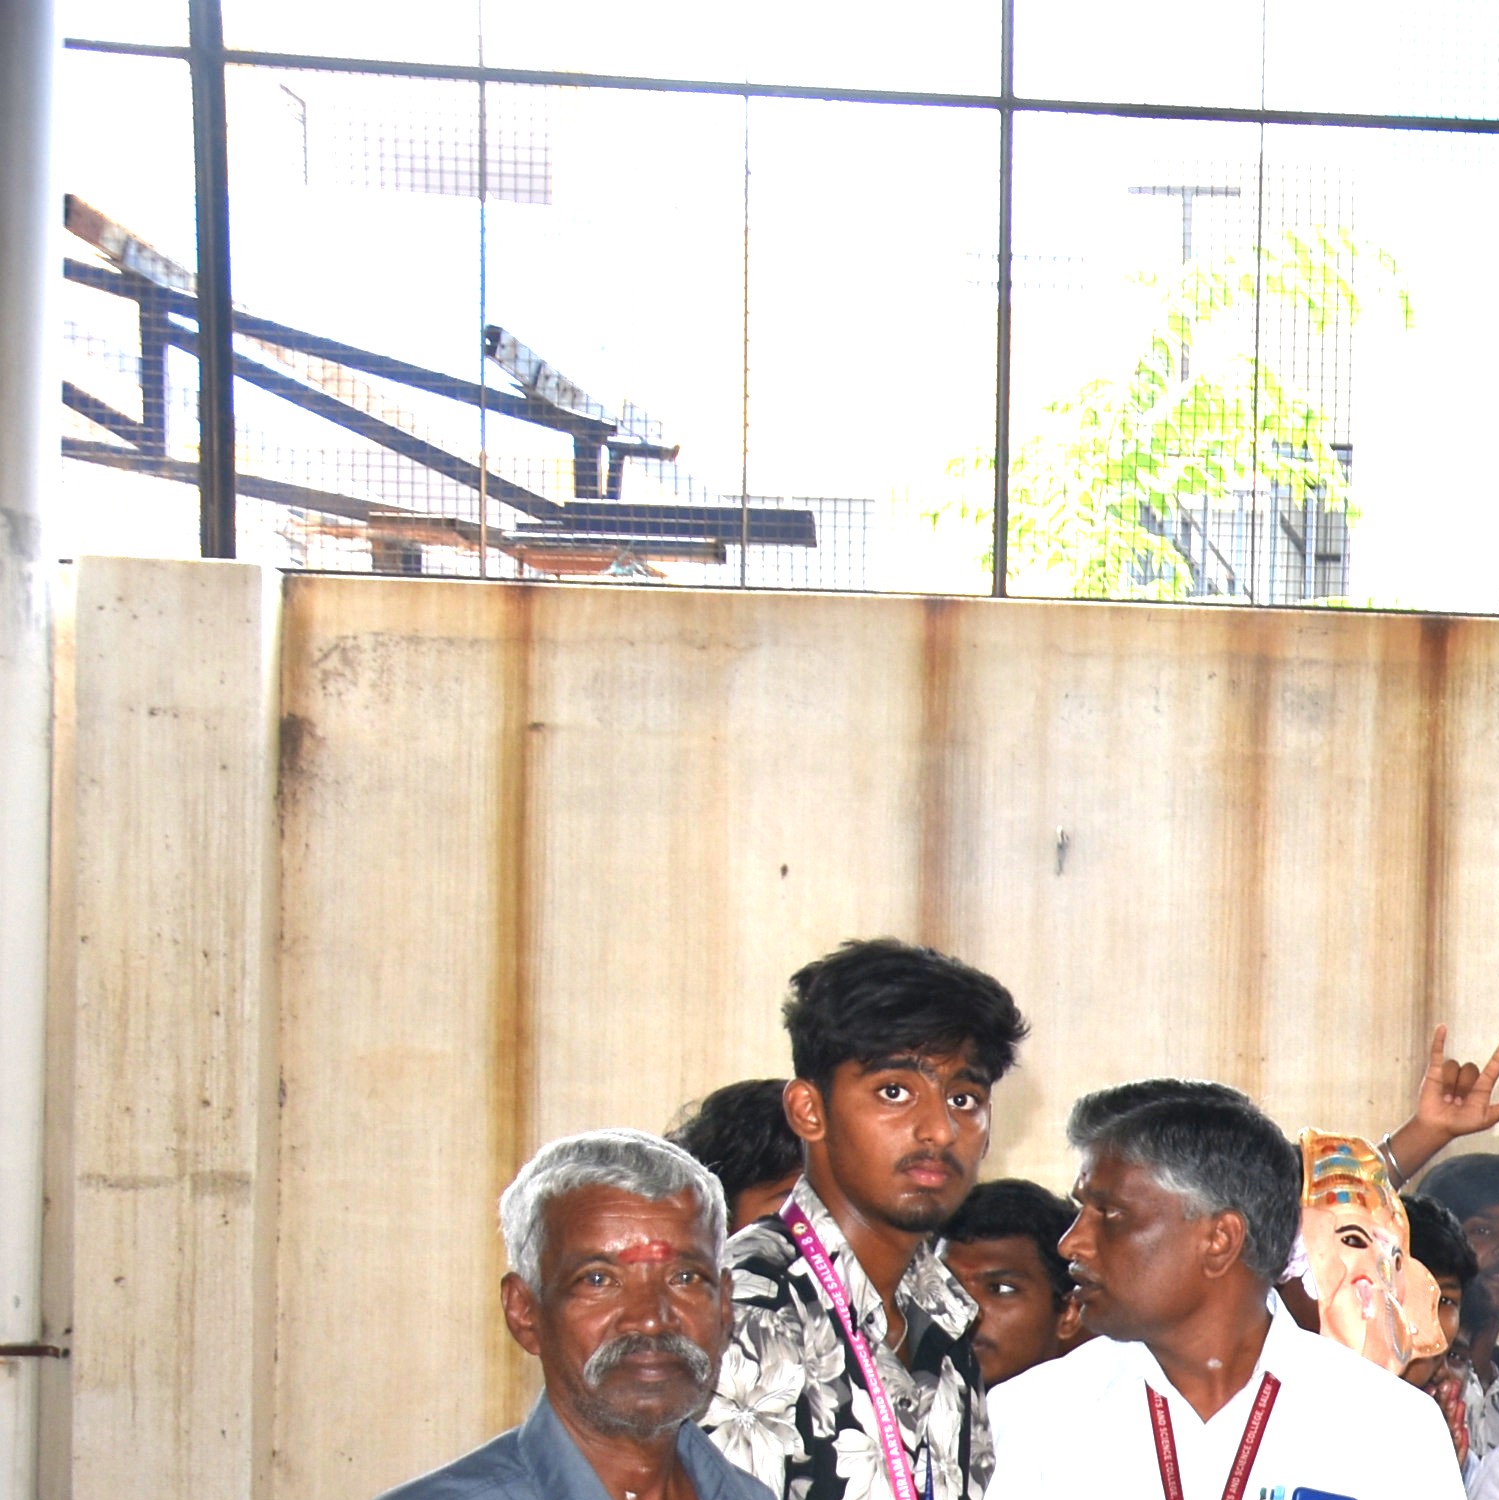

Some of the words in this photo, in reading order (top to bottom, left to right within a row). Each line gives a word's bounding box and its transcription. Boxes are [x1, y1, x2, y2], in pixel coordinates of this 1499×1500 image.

[801, 1236, 813, 1245] 8
[812, 1254, 837, 1289] SALEM
[856, 1344, 880, 1394] SCIENCE
[876, 1396, 890, 1421] AND
[1156, 1409, 1165, 1425] AND
[884, 1424, 899, 1456] ARTS
[1159, 1427, 1171, 1460] SCIENCE
[1229, 1477, 1239, 1493] AND
[1234, 1445, 1251, 1475] SCIENCE
[1258, 1384, 1271, 1407] SALEM
